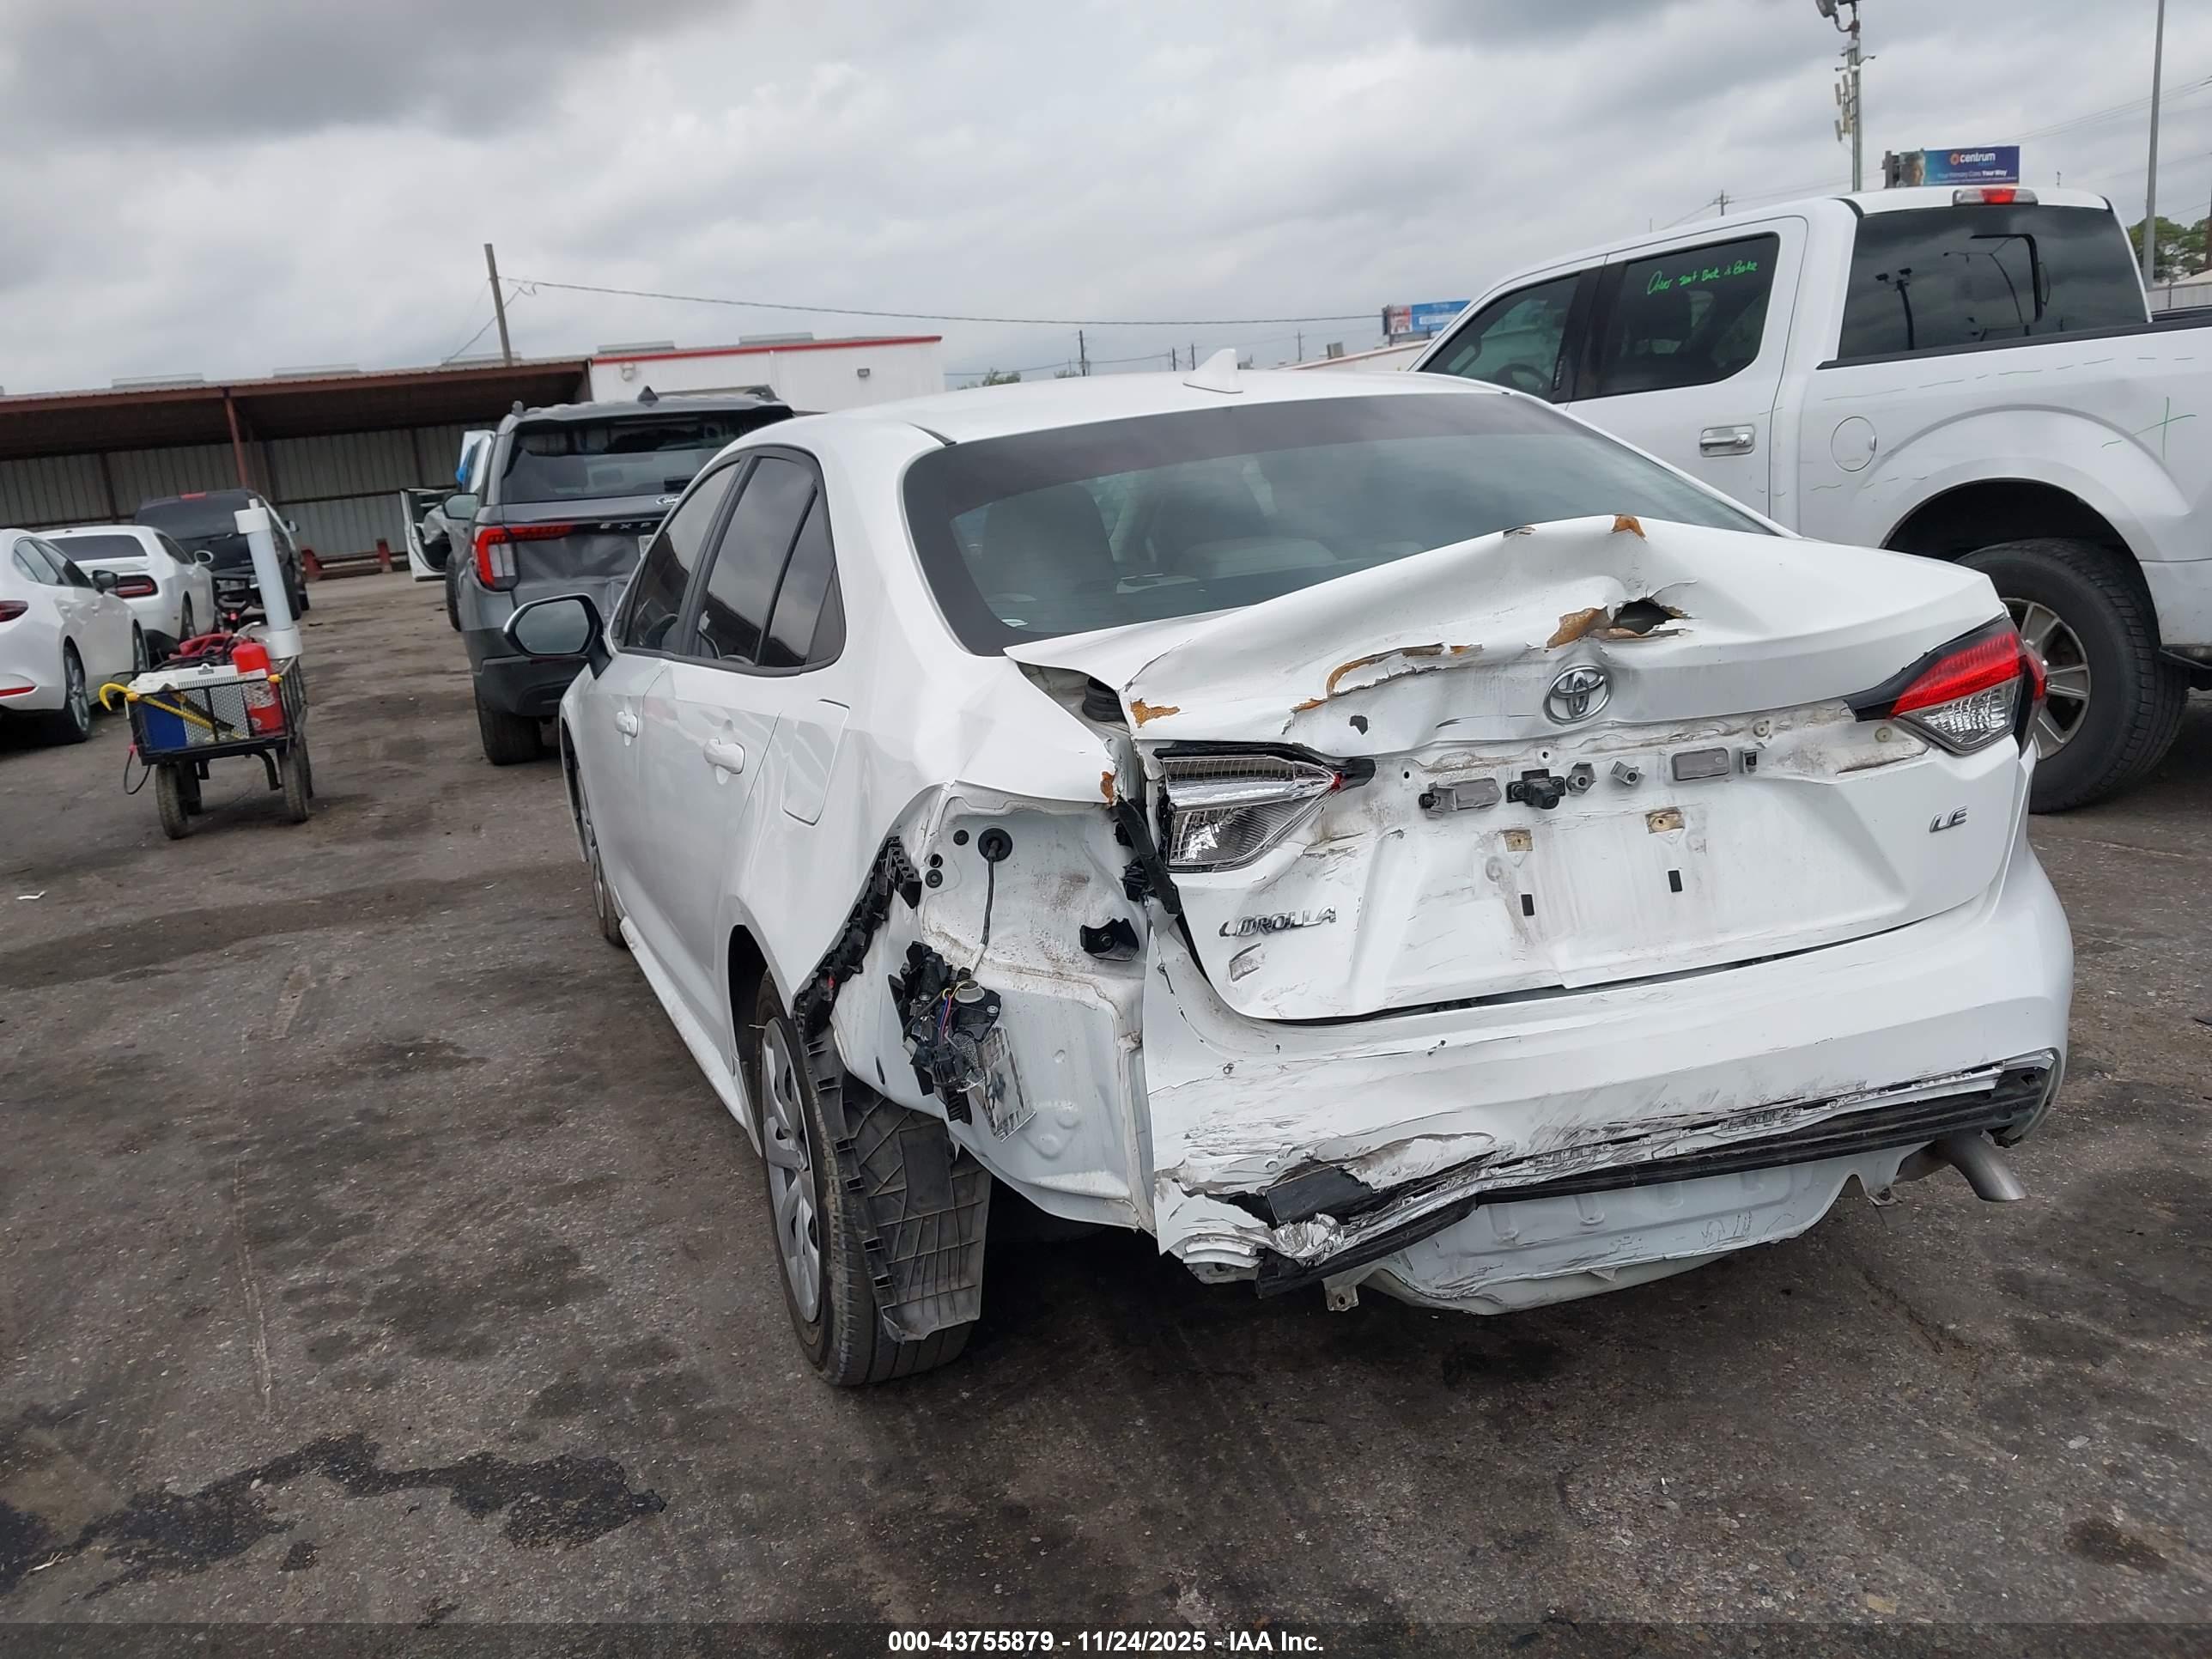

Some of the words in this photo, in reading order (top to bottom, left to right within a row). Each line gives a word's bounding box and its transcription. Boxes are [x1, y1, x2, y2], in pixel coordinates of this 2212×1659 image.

[1960, 153, 1996, 163] centrum
[1929, 805, 1968, 833] LE
[1218, 904, 1337, 938] COROLLA
